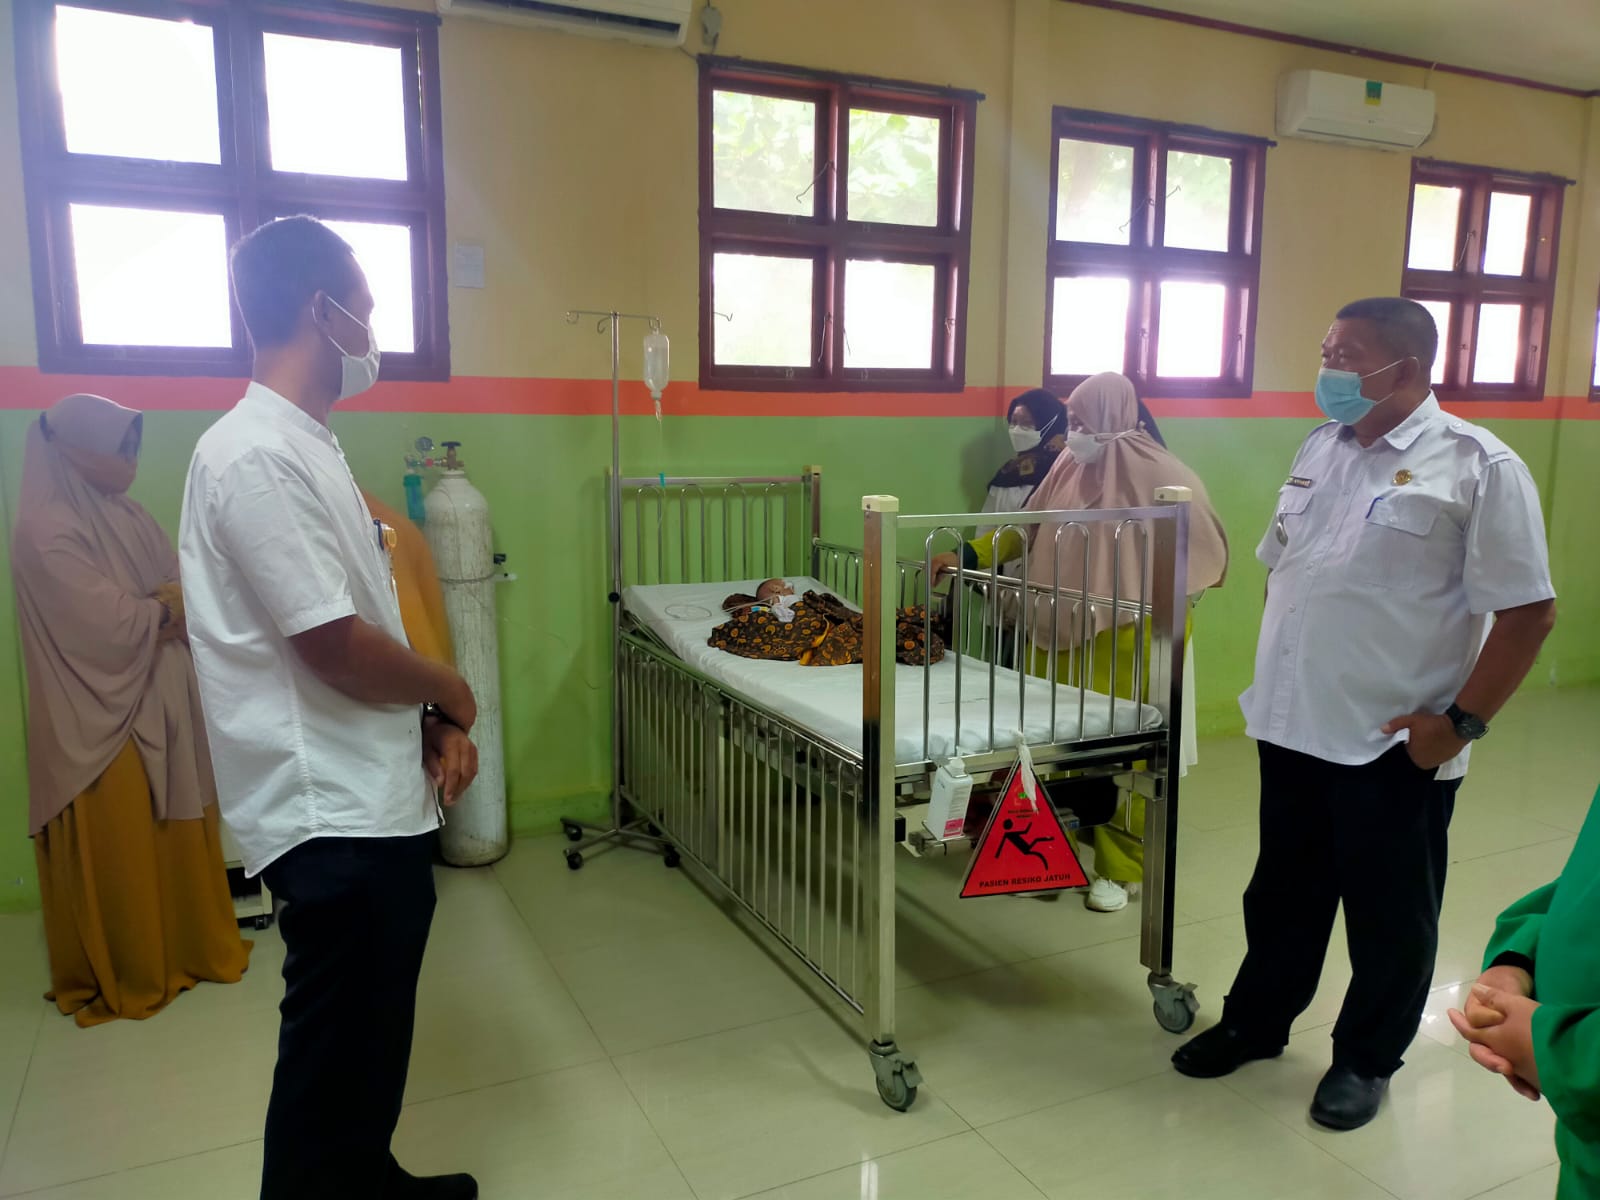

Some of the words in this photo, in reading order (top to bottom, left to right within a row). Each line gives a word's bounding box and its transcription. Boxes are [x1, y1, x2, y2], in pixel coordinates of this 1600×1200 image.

[979, 880, 1009, 888] PASIEN
[1011, 877, 1042, 885] RESIKO
[1044, 874, 1071, 882] JATUH
